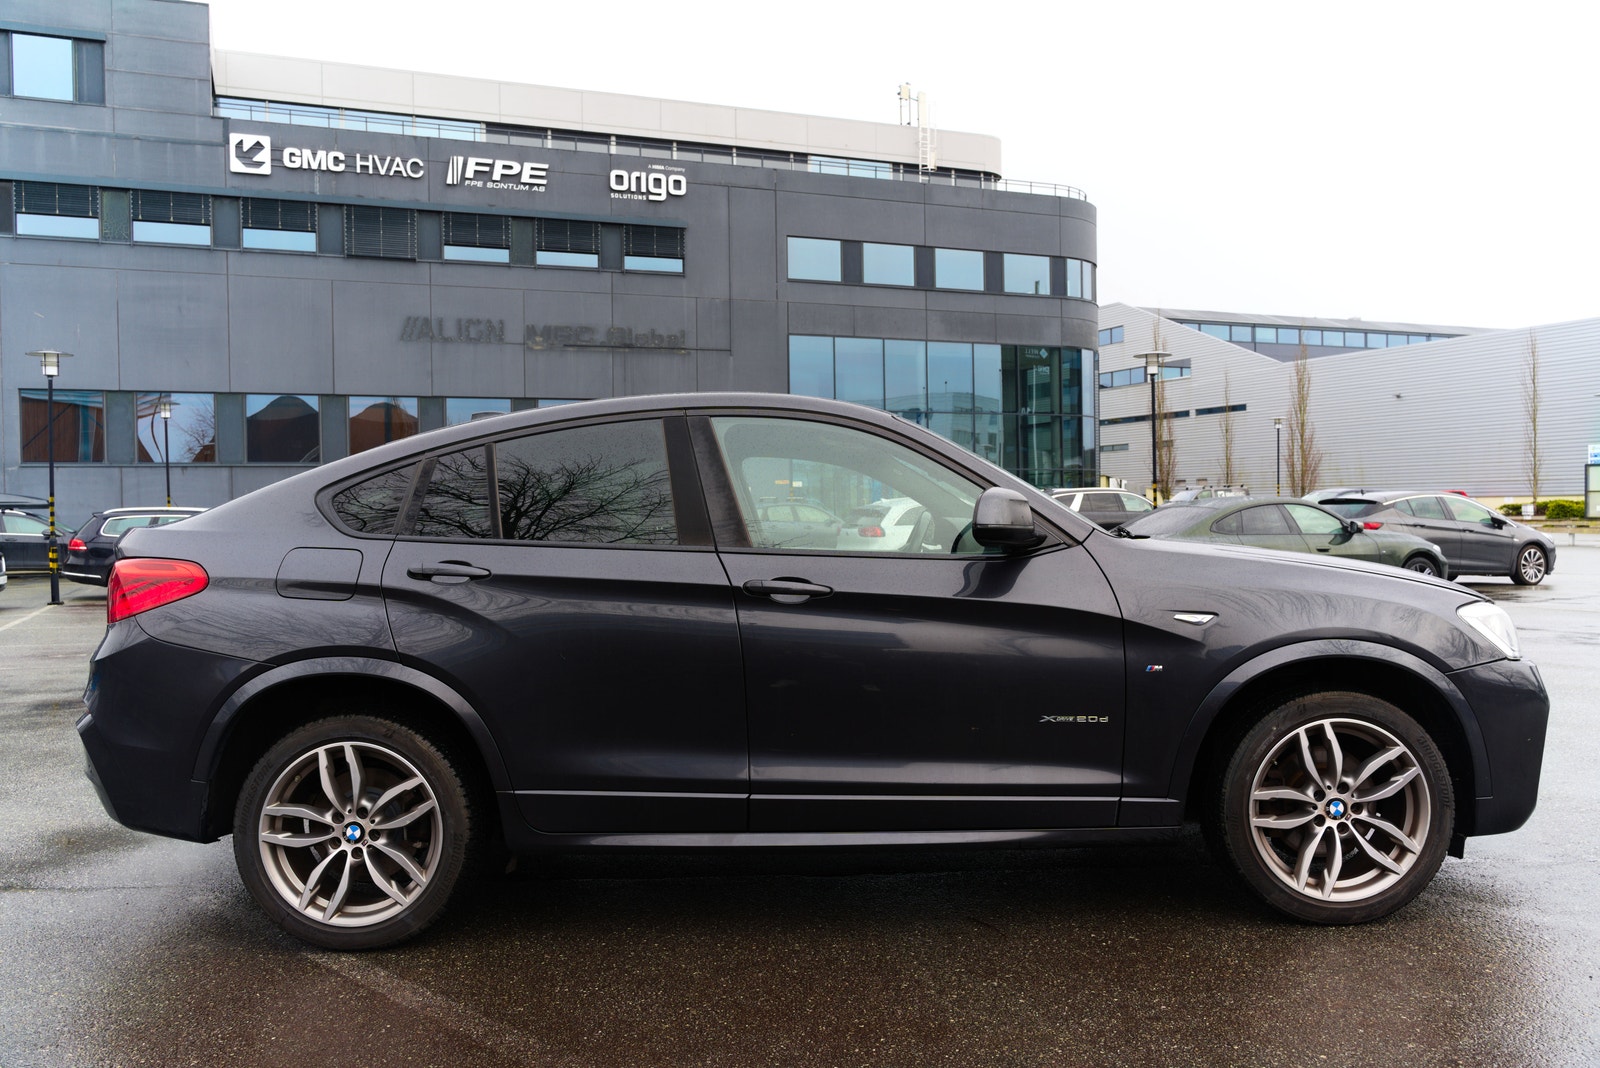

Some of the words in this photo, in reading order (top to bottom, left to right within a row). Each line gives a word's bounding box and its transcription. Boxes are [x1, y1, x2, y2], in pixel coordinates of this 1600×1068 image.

[283, 147, 346, 172] GMC
[355, 153, 425, 179] HVAC
[464, 157, 549, 184] FPE
[665, 165, 685, 173] Company
[486, 181, 529, 191] SONTUM
[610, 169, 687, 201] origo
[610, 192, 647, 201] SOLUTIONS
